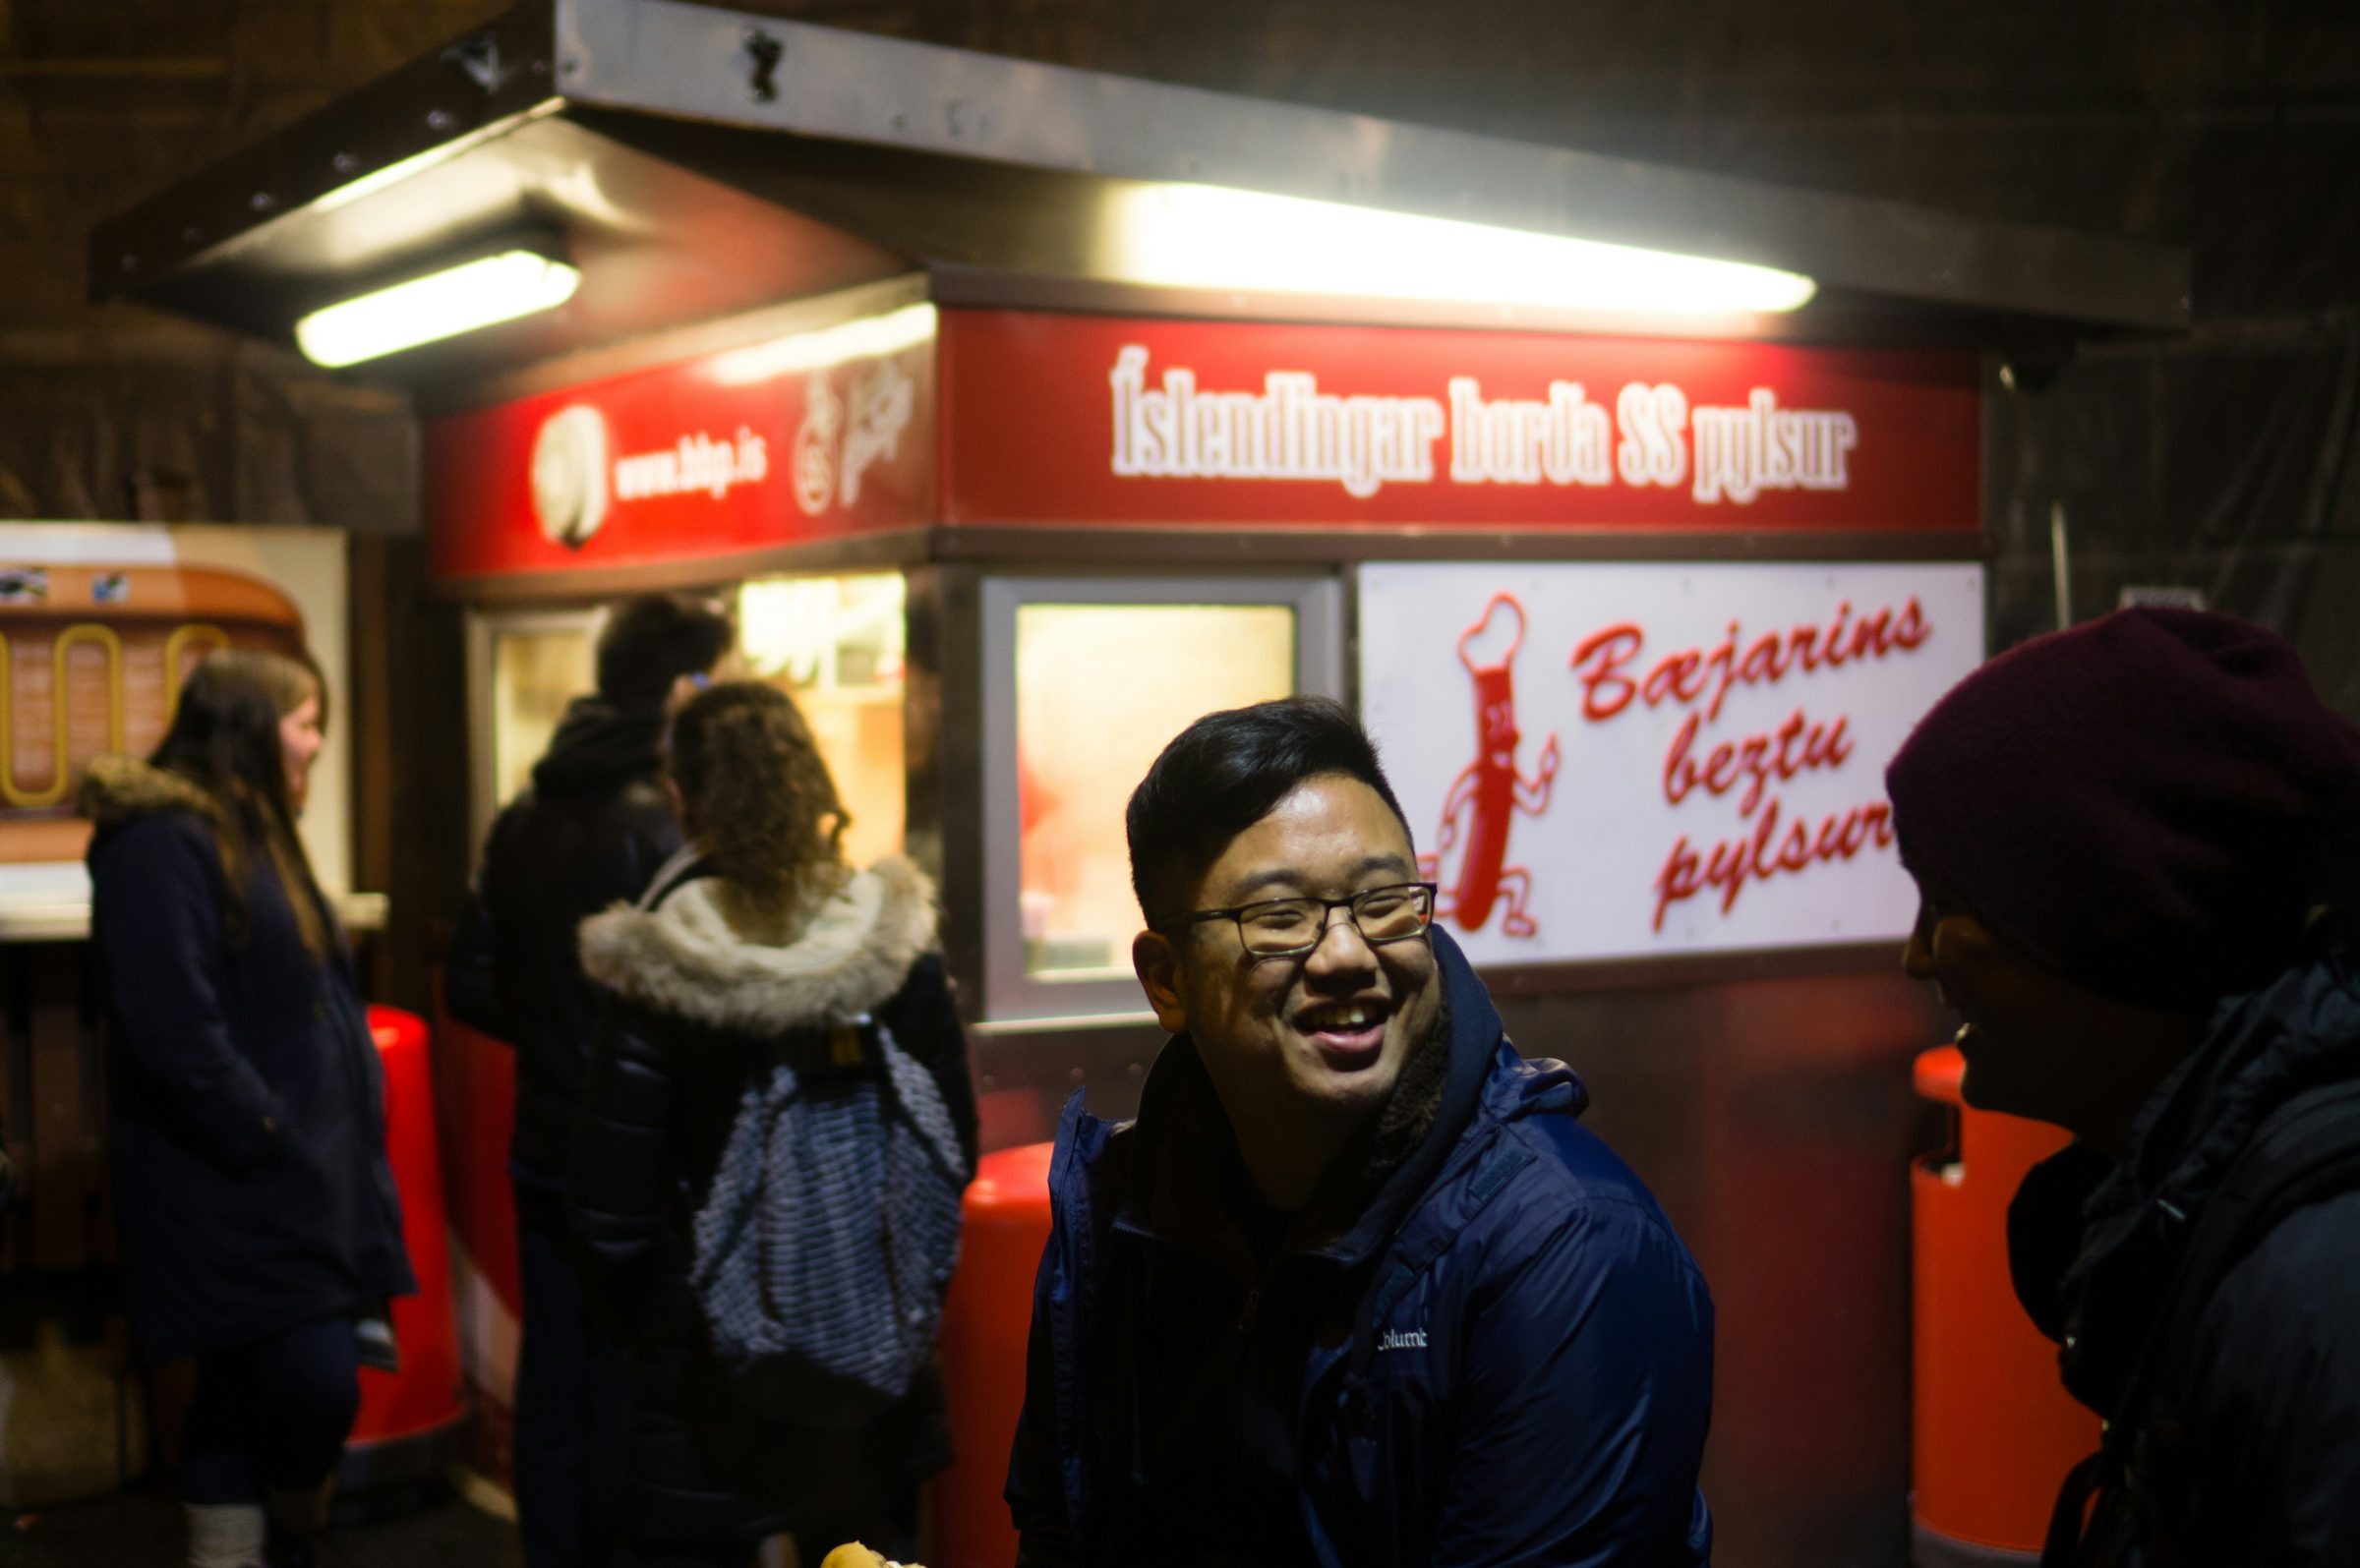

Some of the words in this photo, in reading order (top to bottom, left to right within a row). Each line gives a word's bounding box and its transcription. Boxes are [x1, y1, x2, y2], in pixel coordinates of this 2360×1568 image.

[615, 425, 768, 500] www.bbp.is
[1617, 380, 1688, 487] SS
[1691, 386, 1857, 504] pylsur
[1570, 595, 1932, 723] Bæjarins
[1664, 708, 1854, 818] beztu
[1653, 799, 1894, 935] pylsur
